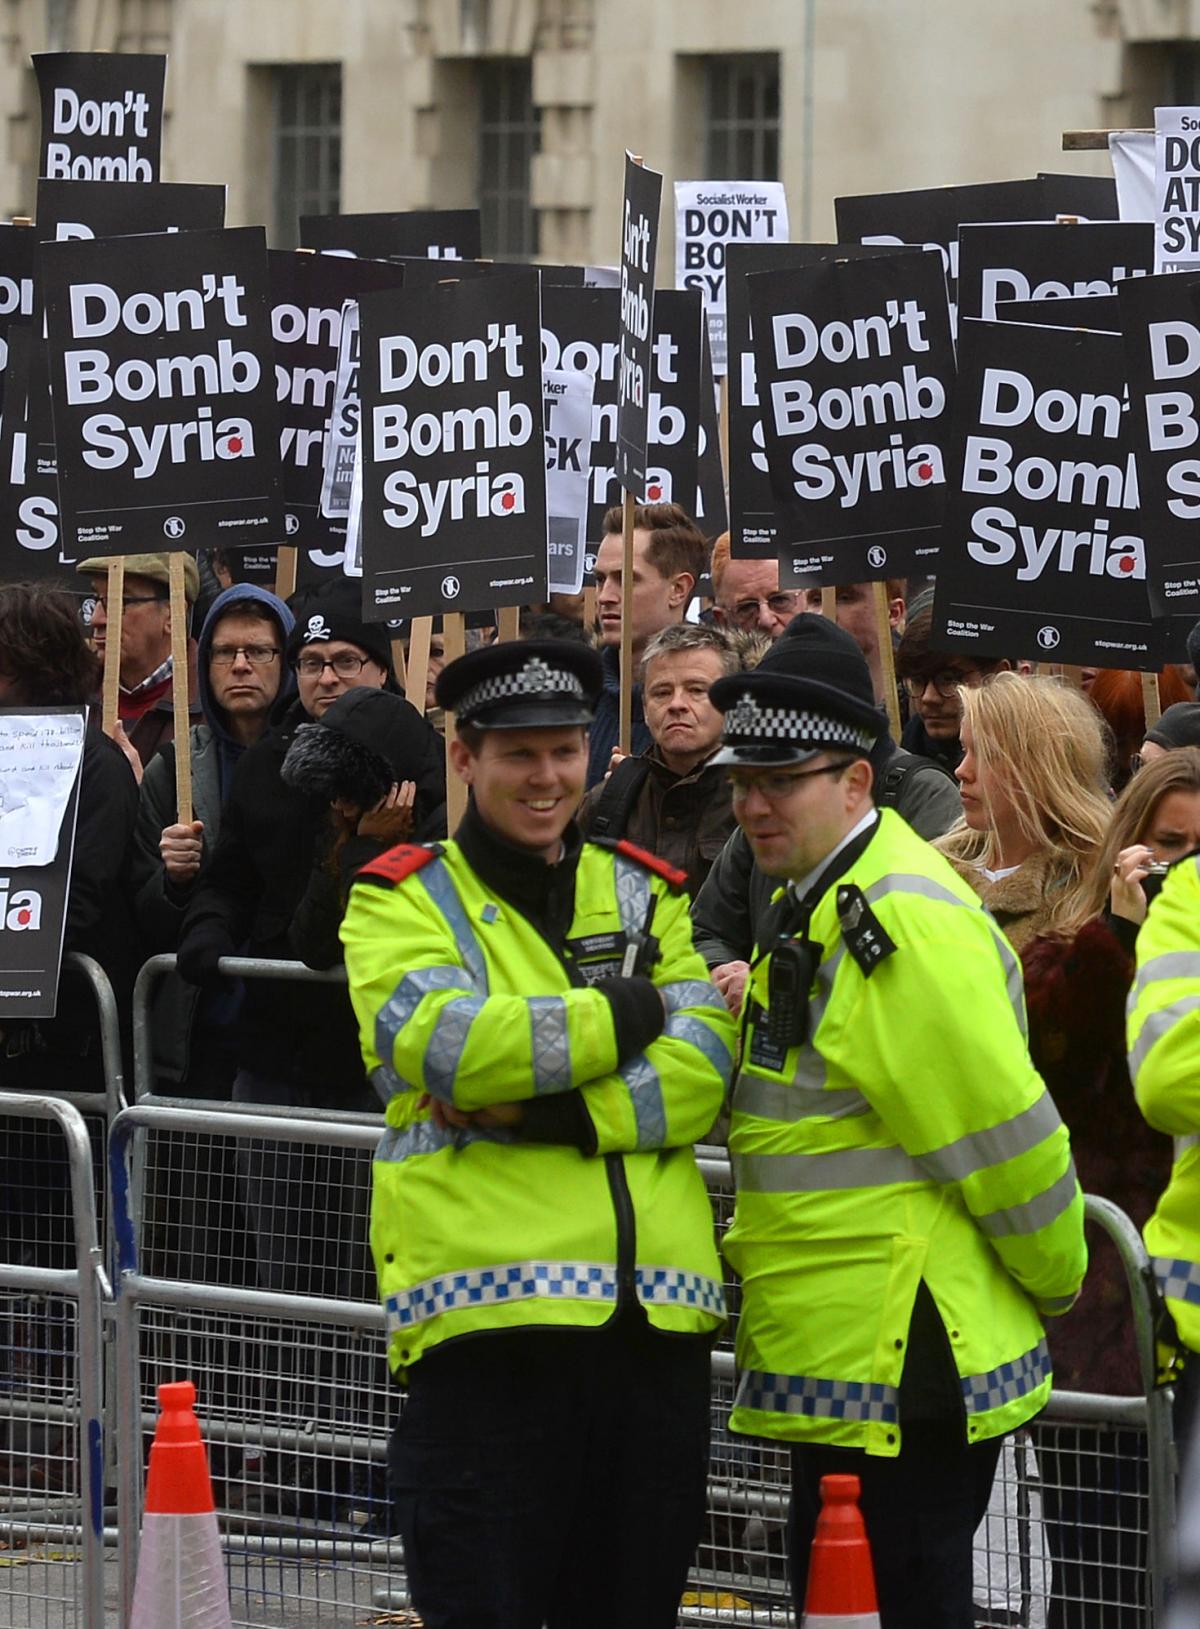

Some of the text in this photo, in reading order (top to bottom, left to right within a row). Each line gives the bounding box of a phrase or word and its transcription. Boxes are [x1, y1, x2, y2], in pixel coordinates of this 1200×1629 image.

[54, 87, 149, 138] Don't
[684, 209, 777, 238] DON'T
[69, 273, 248, 339] Don't
[772, 300, 930, 370] Don't
[64, 339, 261, 406] Bomb
[379, 323, 525, 394] Don't
[372, 391, 533, 463] Bomb
[770, 365, 946, 437] Bomb
[81, 406, 256, 479] Syria
[792, 434, 947, 509] Syria
[78, 527, 93, 535] Stop
[94, 526, 107, 534] the
[382, 461, 526, 538] Syria
[967, 506, 1147, 582] Syria
[948, 620, 995, 632] Stop the War
